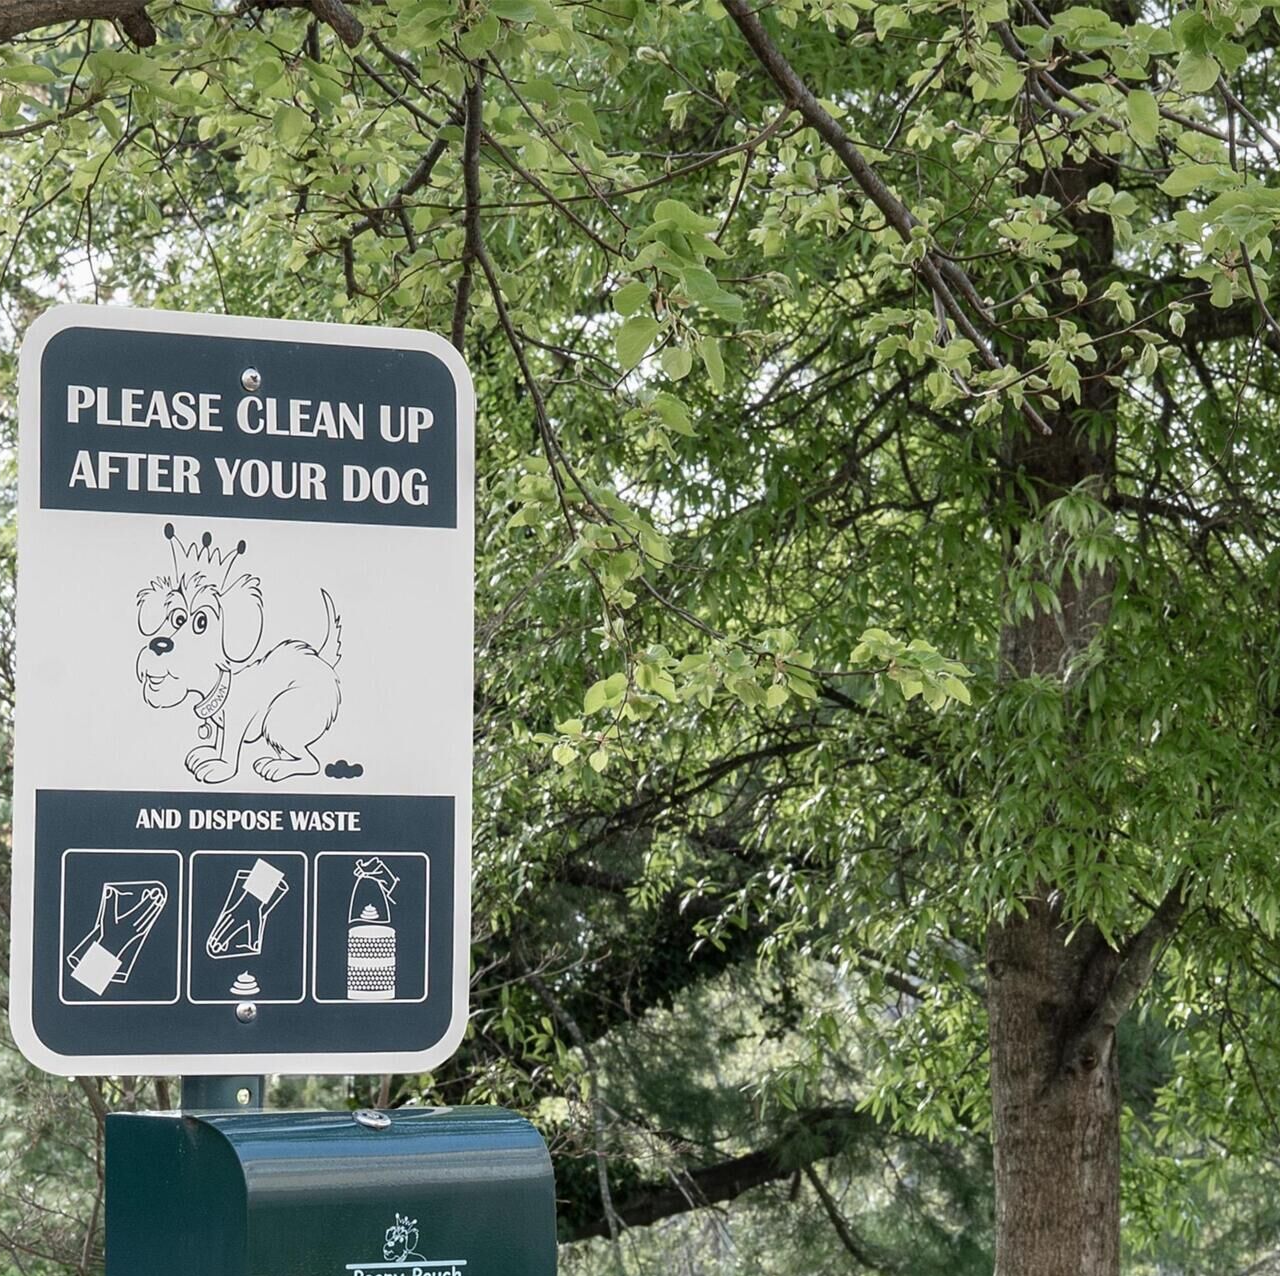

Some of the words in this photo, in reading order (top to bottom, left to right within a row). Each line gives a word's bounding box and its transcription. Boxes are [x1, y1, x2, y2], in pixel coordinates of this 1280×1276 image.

[67, 384, 223, 432] PLEASE
[236, 395, 364, 441] CLEAN
[379, 404, 434, 443] UP
[68, 449, 202, 495] AFTER
[214, 457, 327, 501] YOUR
[342, 464, 429, 506] DOG
[200, 684, 228, 717] CROWN
[135, 808, 182, 830] AND
[189, 809, 283, 832] DISPOSE
[289, 811, 361, 832] WASTE
